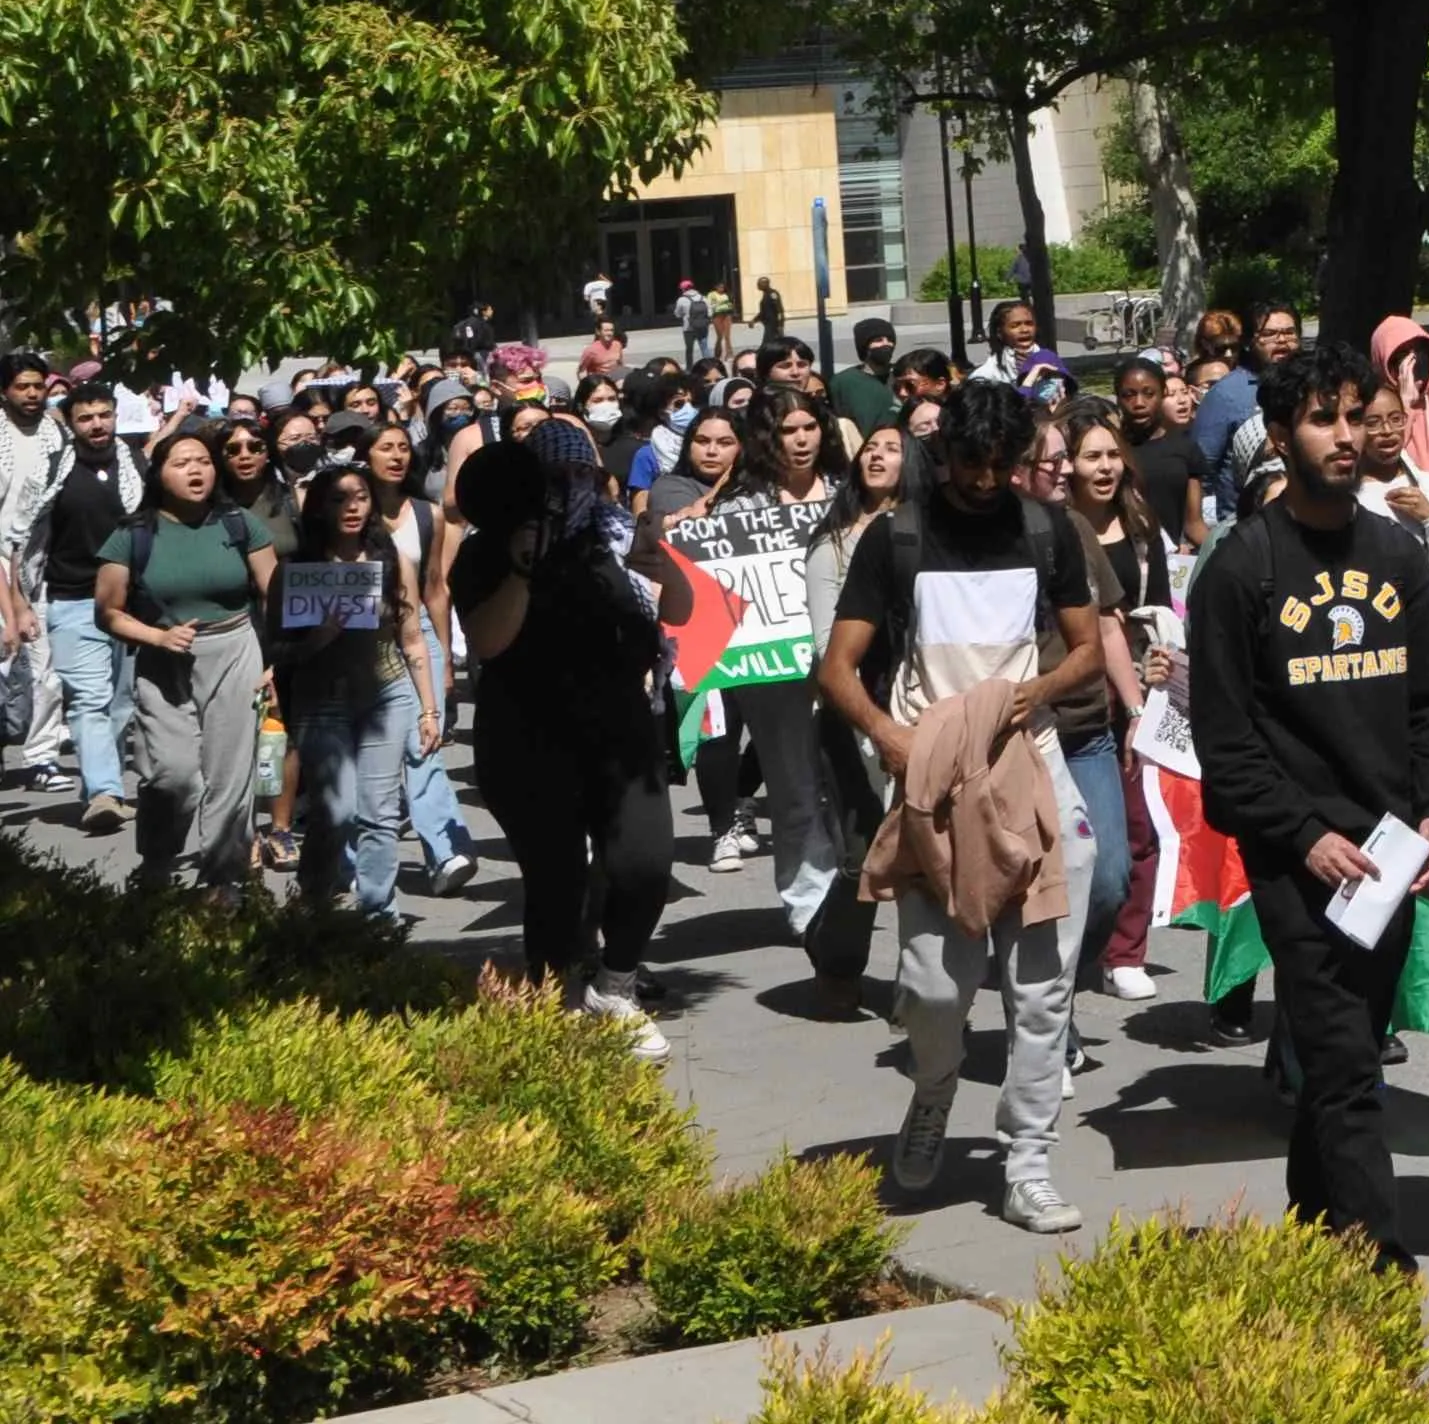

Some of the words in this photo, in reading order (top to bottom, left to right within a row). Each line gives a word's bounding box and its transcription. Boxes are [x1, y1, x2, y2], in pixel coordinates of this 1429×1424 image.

[665, 515, 728, 544] FROM
[734, 507, 784, 531] THE
[701, 539, 734, 559] TO
[748, 528, 798, 553] THE
[289, 571, 383, 587] DISCLOSE
[289, 595, 376, 616] DIVEST
[1280, 569, 1401, 634] SJSU
[715, 647, 797, 678] WILL
[1288, 646, 1407, 685] SPARTANS
